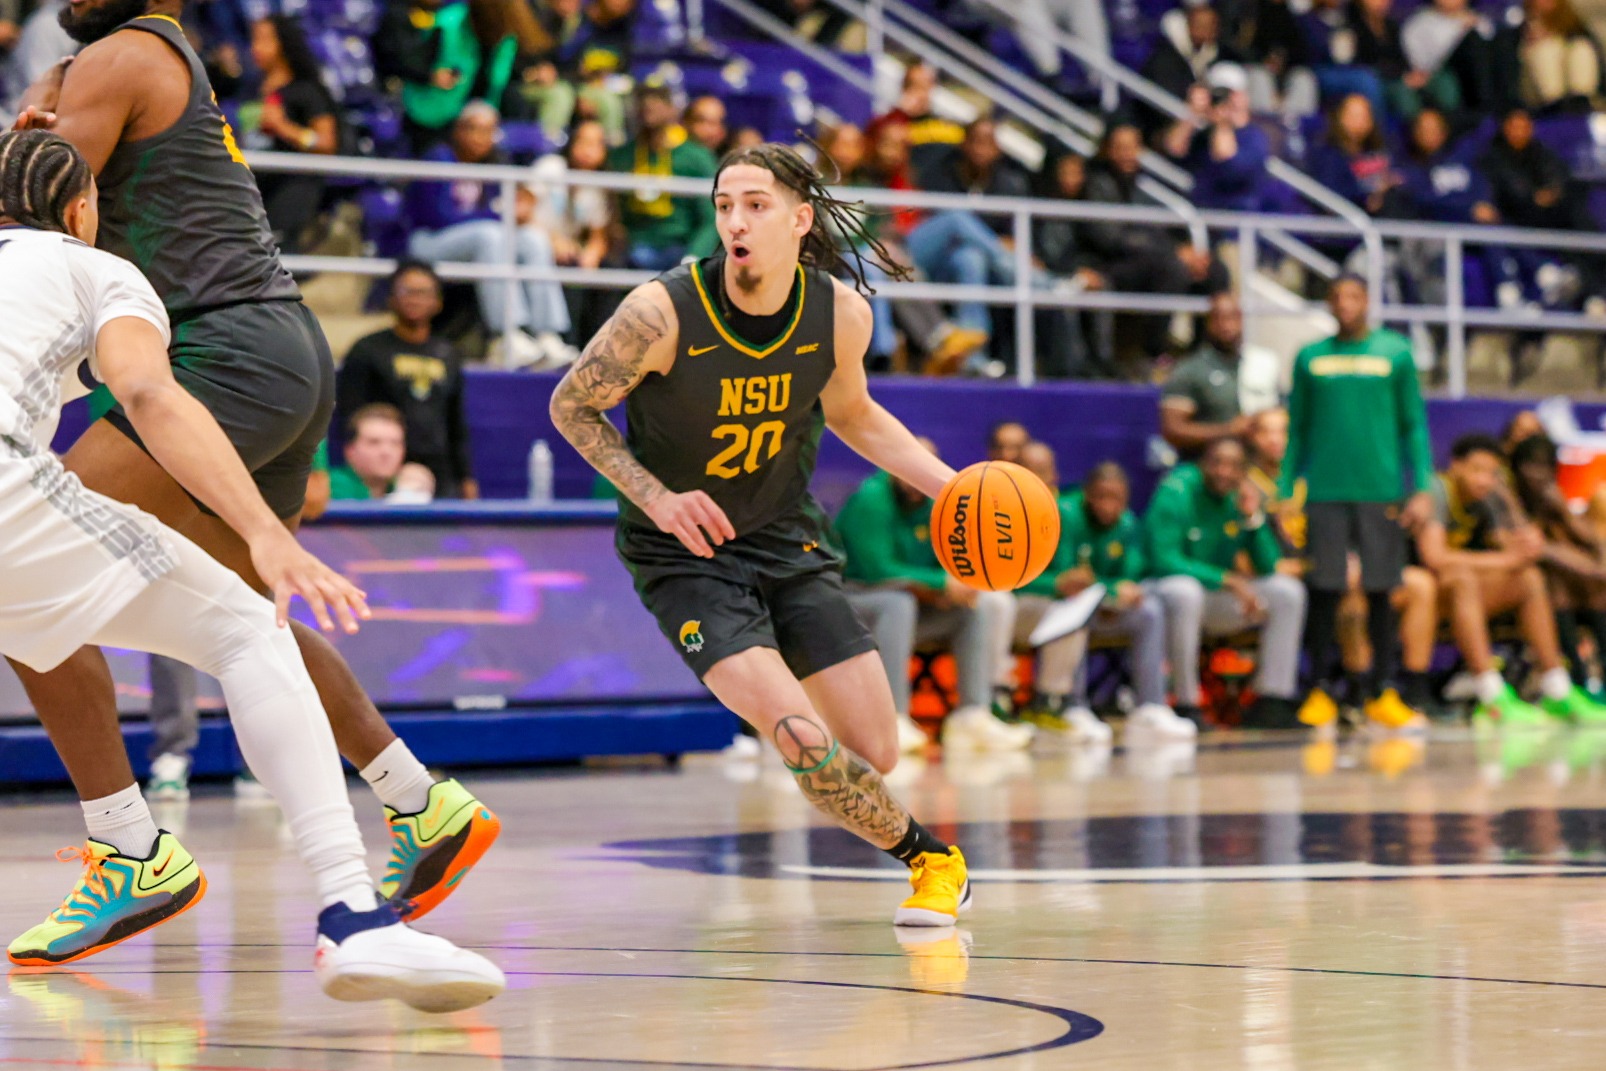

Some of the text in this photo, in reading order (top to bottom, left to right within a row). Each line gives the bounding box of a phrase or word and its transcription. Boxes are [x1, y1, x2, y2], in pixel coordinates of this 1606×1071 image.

[717, 373, 792, 416] NSU
[705, 420, 786, 479] 20
[948, 494, 976, 577] Wilson
[994, 511, 1014, 561] EVO
